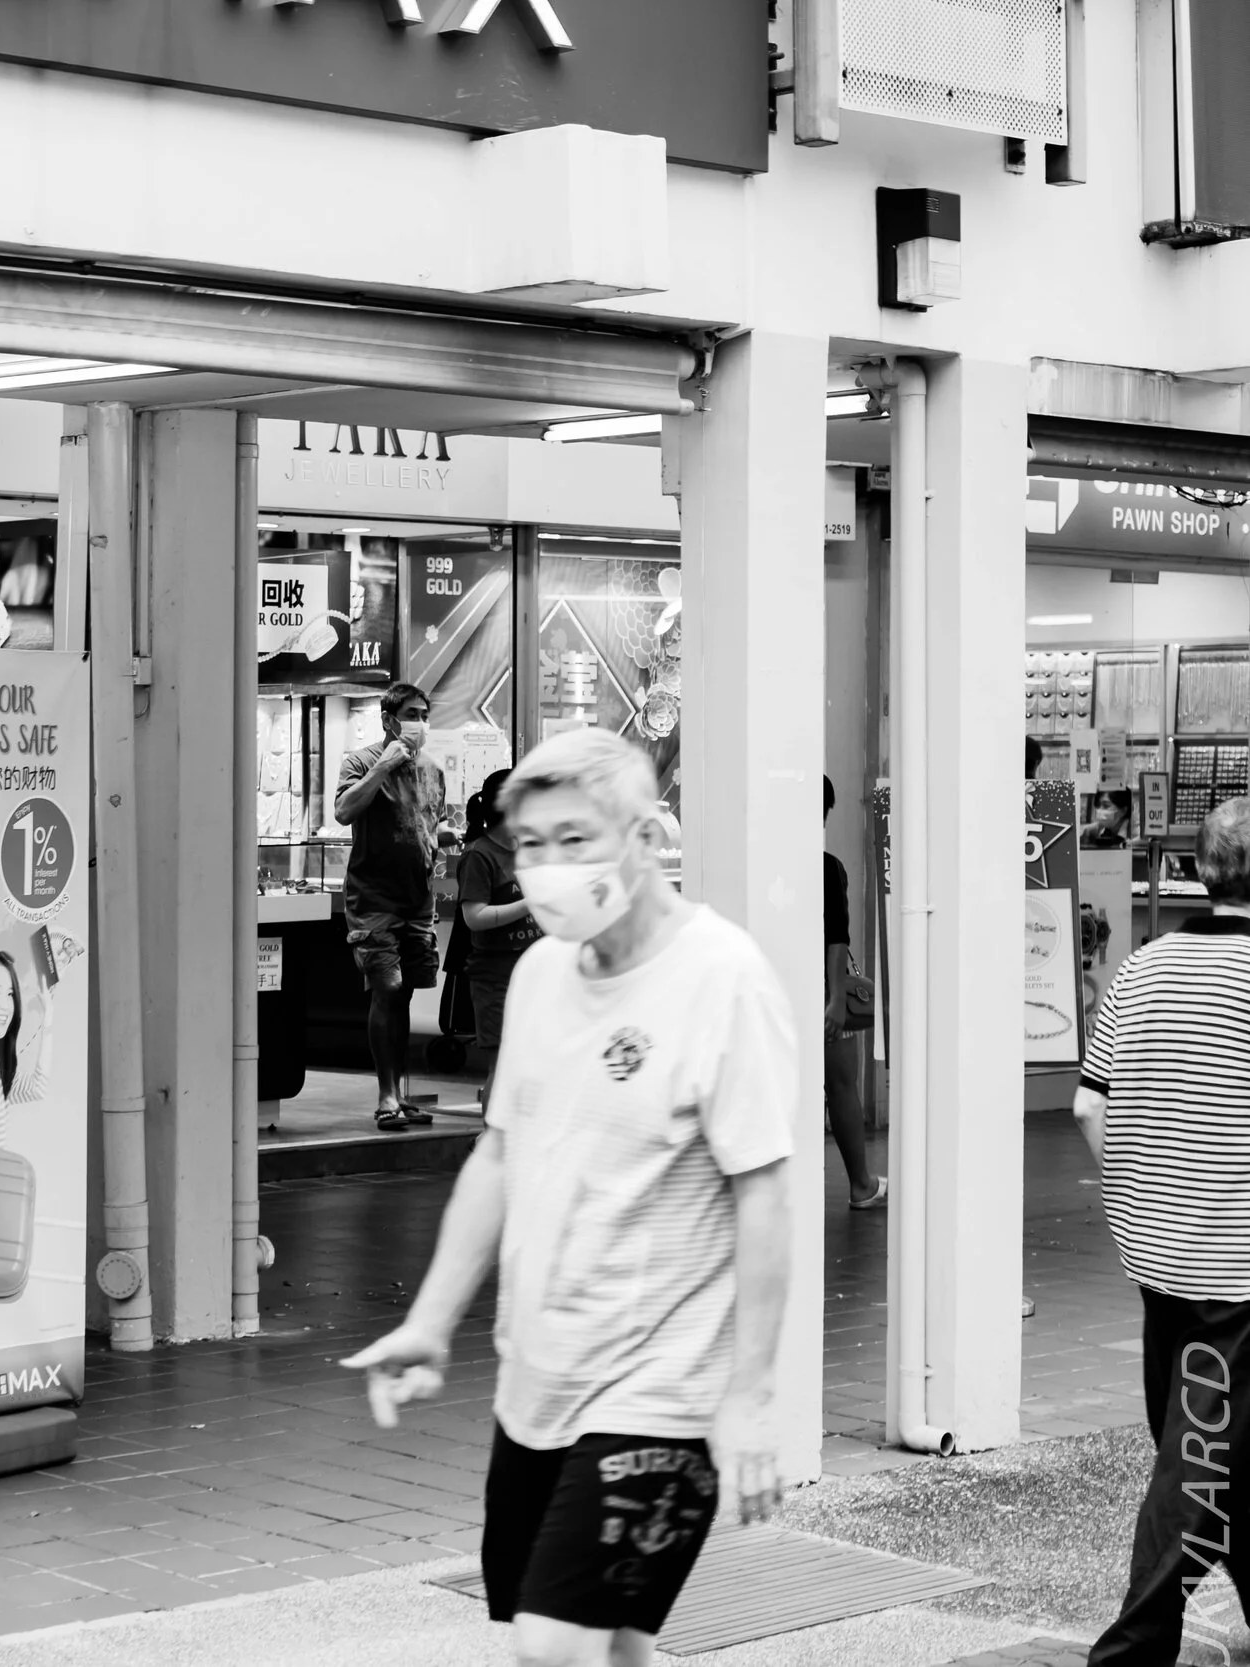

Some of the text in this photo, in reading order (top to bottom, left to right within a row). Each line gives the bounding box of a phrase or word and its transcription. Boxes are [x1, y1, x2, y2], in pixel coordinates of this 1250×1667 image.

[285, 458, 449, 490] JEWELLERY
[1112, 506, 1220, 536] PAWN SHOP
[426, 557, 454, 574] 999
[262, 579, 305, 608] 回收
[426, 578, 463, 596] GOLD
[270, 612, 303, 626] GOLD
[349, 641, 381, 661] AKA
[17, 724, 59, 756] SAFE
[1151, 782, 1160, 792] IN
[1149, 809, 1163, 821] OUT
[15, 893, 71, 923] TRANSACTIONS
[259, 944, 279, 952] GOLD
